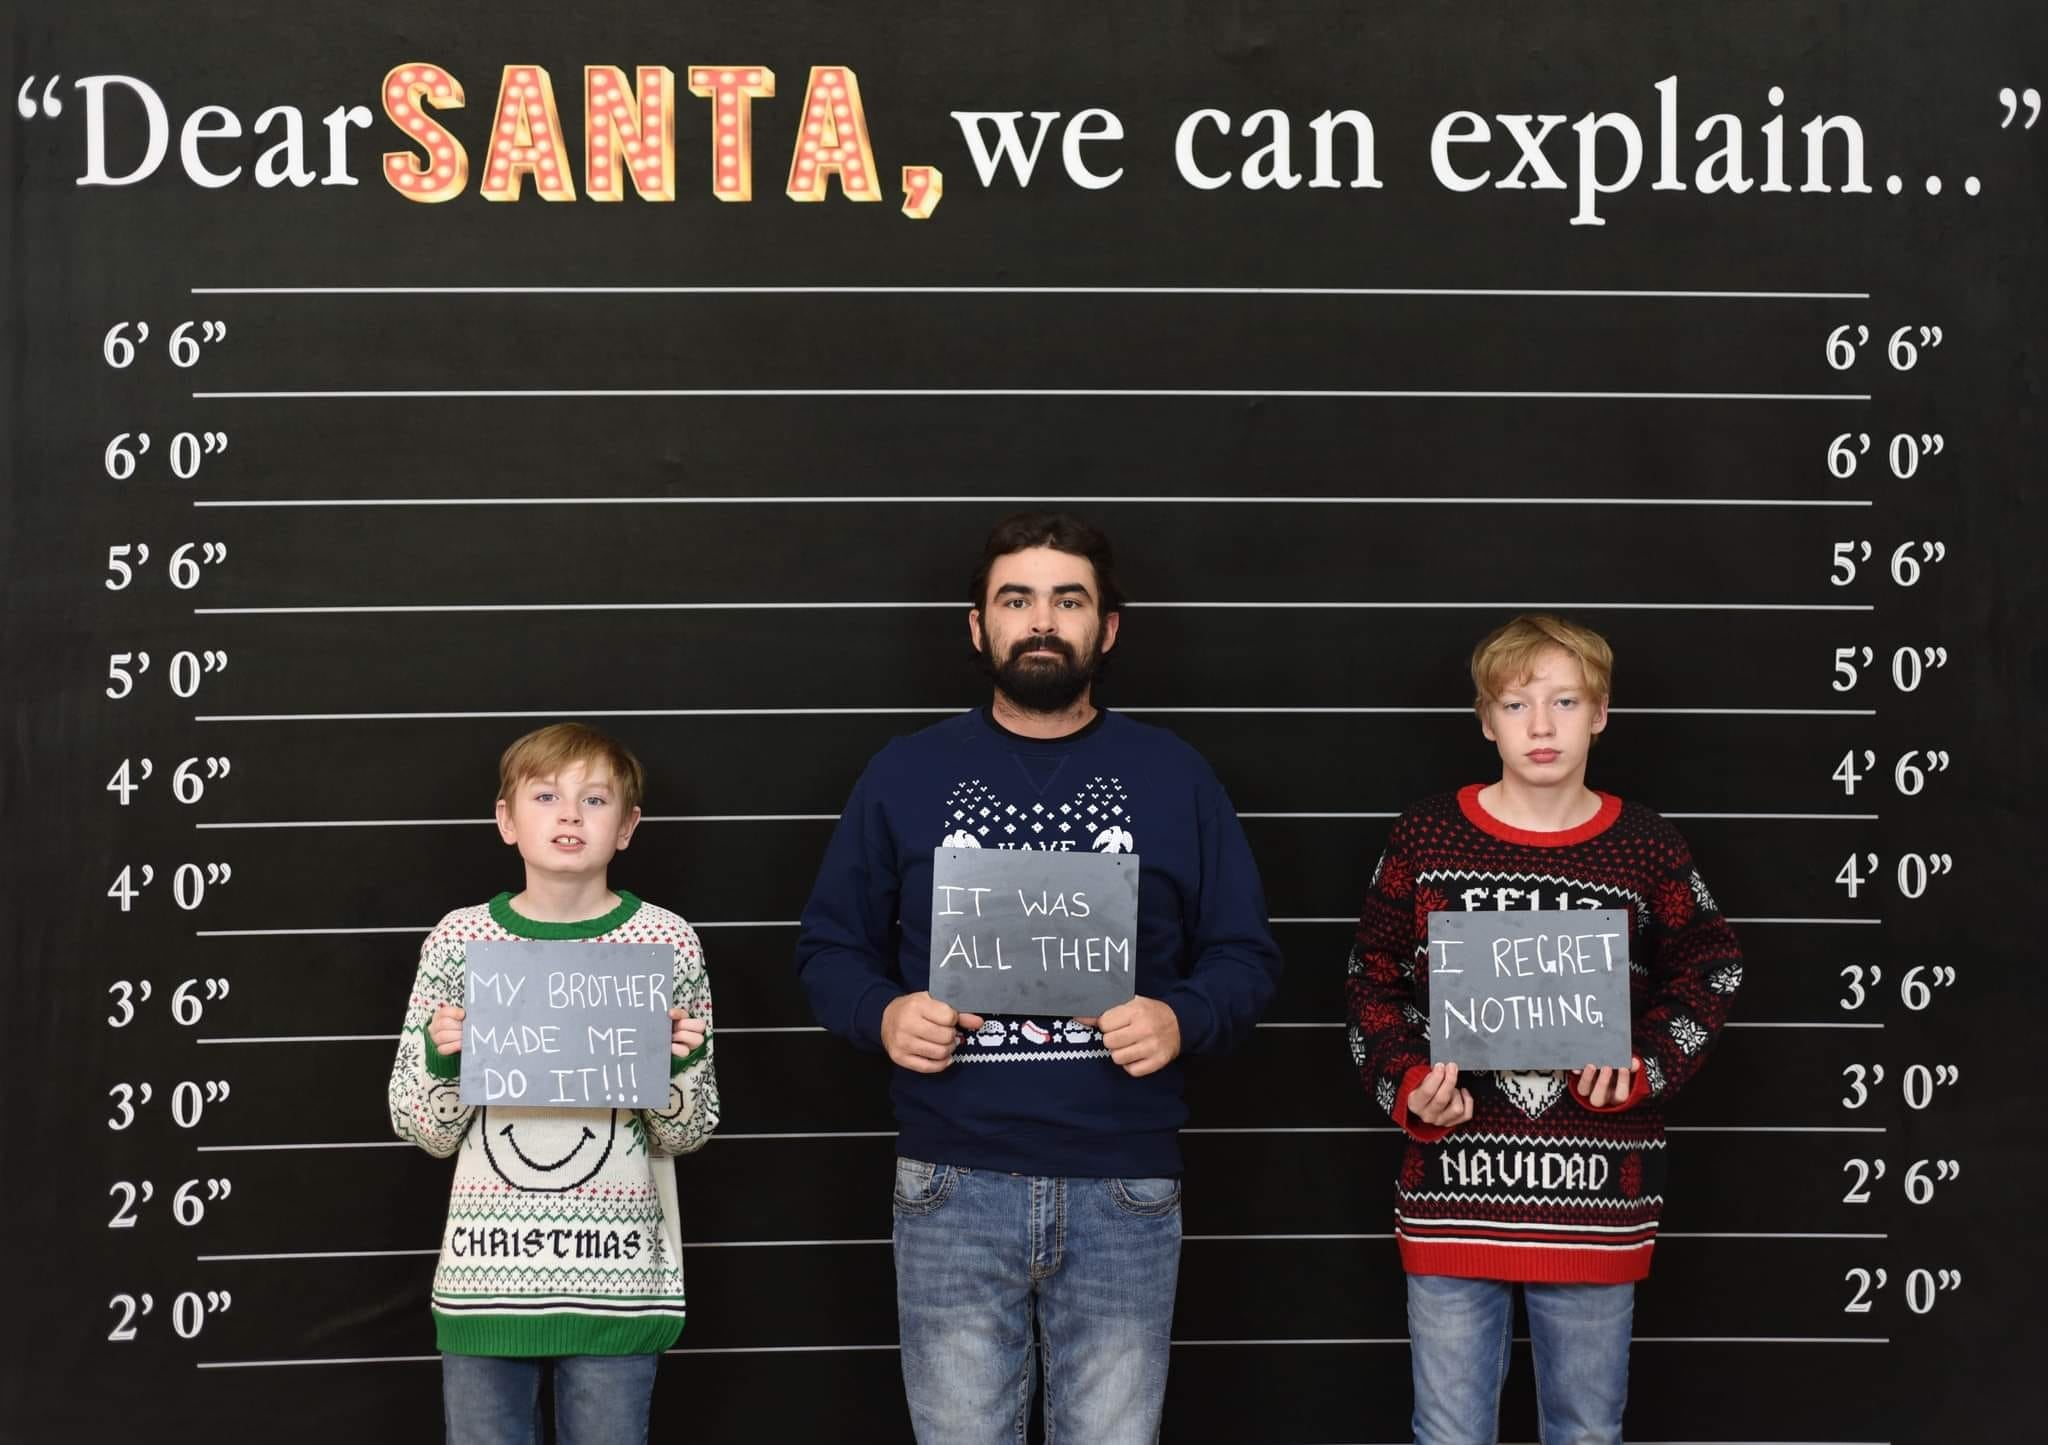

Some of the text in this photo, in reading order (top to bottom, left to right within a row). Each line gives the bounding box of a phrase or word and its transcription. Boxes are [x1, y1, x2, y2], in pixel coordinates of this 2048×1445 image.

[381, 61, 943, 219] SANTA,
[950, 109, 1124, 190] we
[1175, 109, 1383, 190] can
[104, 321, 226, 368] 6’ 6”
[1826, 325, 1942, 370] 6’ 6”
[105, 432, 227, 479] 6’ 0”
[1828, 433, 1944, 479] 6’ 0”
[105, 542, 226, 590] 5’ 6”
[1831, 541, 1945, 586] 5’ 6”
[106, 651, 227, 699] 5’ 0”
[1833, 646, 1947, 691] 5’ 0”
[107, 757, 230, 805] 4’ 6”
[1832, 750, 1949, 795] 4’ 6”
[108, 863, 231, 911] 4’ 0”
[1836, 853, 1952, 898] 4’ 0”
[937, 885, 1090, 918] IT WAS
[939, 933, 1129, 973] ALL THEM
[1431, 933, 1621, 978] I REGRET
[108, 978, 230, 1027] 3’ 6”
[470, 970, 668, 1013] MY BROTHER
[1840, 965, 1955, 1010] 3’ 6”
[471, 1023, 638, 1057] MADE ME
[109, 1081, 230, 1130] 3’ 0”
[484, 1062, 639, 1104] DO IT!!!
[1843, 1064, 1958, 1109] 3’ 0”
[1439, 1148, 1610, 1191] NAVIDAD
[1843, 1159, 1959, 1204] 2’ 6”
[108, 1179, 231, 1227] 2’ 6”
[451, 1226, 642, 1260] CHRISTMAS
[1845, 1268, 1961, 1313] 2’ 0”
[108, 1291, 231, 1340] 2’ 0”
